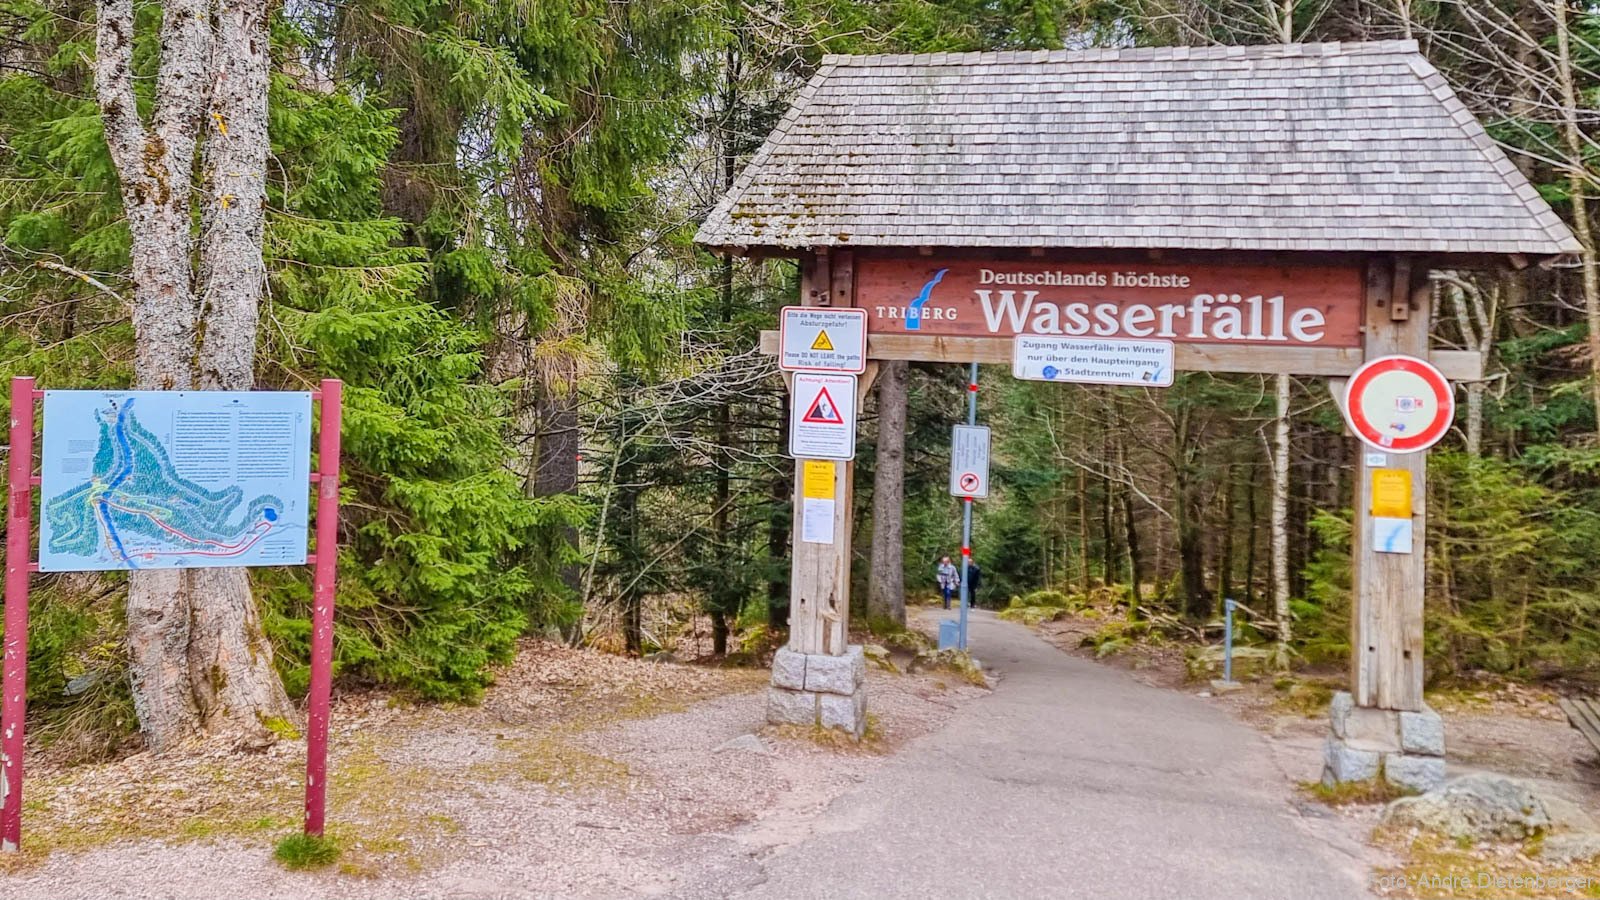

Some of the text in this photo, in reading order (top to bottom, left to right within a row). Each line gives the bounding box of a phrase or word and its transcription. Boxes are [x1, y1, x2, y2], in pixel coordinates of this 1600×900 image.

[979, 268, 1191, 287] Deutschlands höchste
[875, 305, 959, 322] TRIBERG
[974, 289, 1326, 341] Wasserfälle
[800, 320, 848, 328] Absturzgefahr!
[1022, 340, 1058, 351] Zugang
[1061, 342, 1115, 352] Wasserfälle
[1133, 346, 1165, 354] Winter
[1046, 354, 1067, 363] über
[1071, 354, 1089, 363] den
[1091, 356, 1160, 368] Haupteingang
[1065, 367, 1135, 378] Stadtzentrum!
